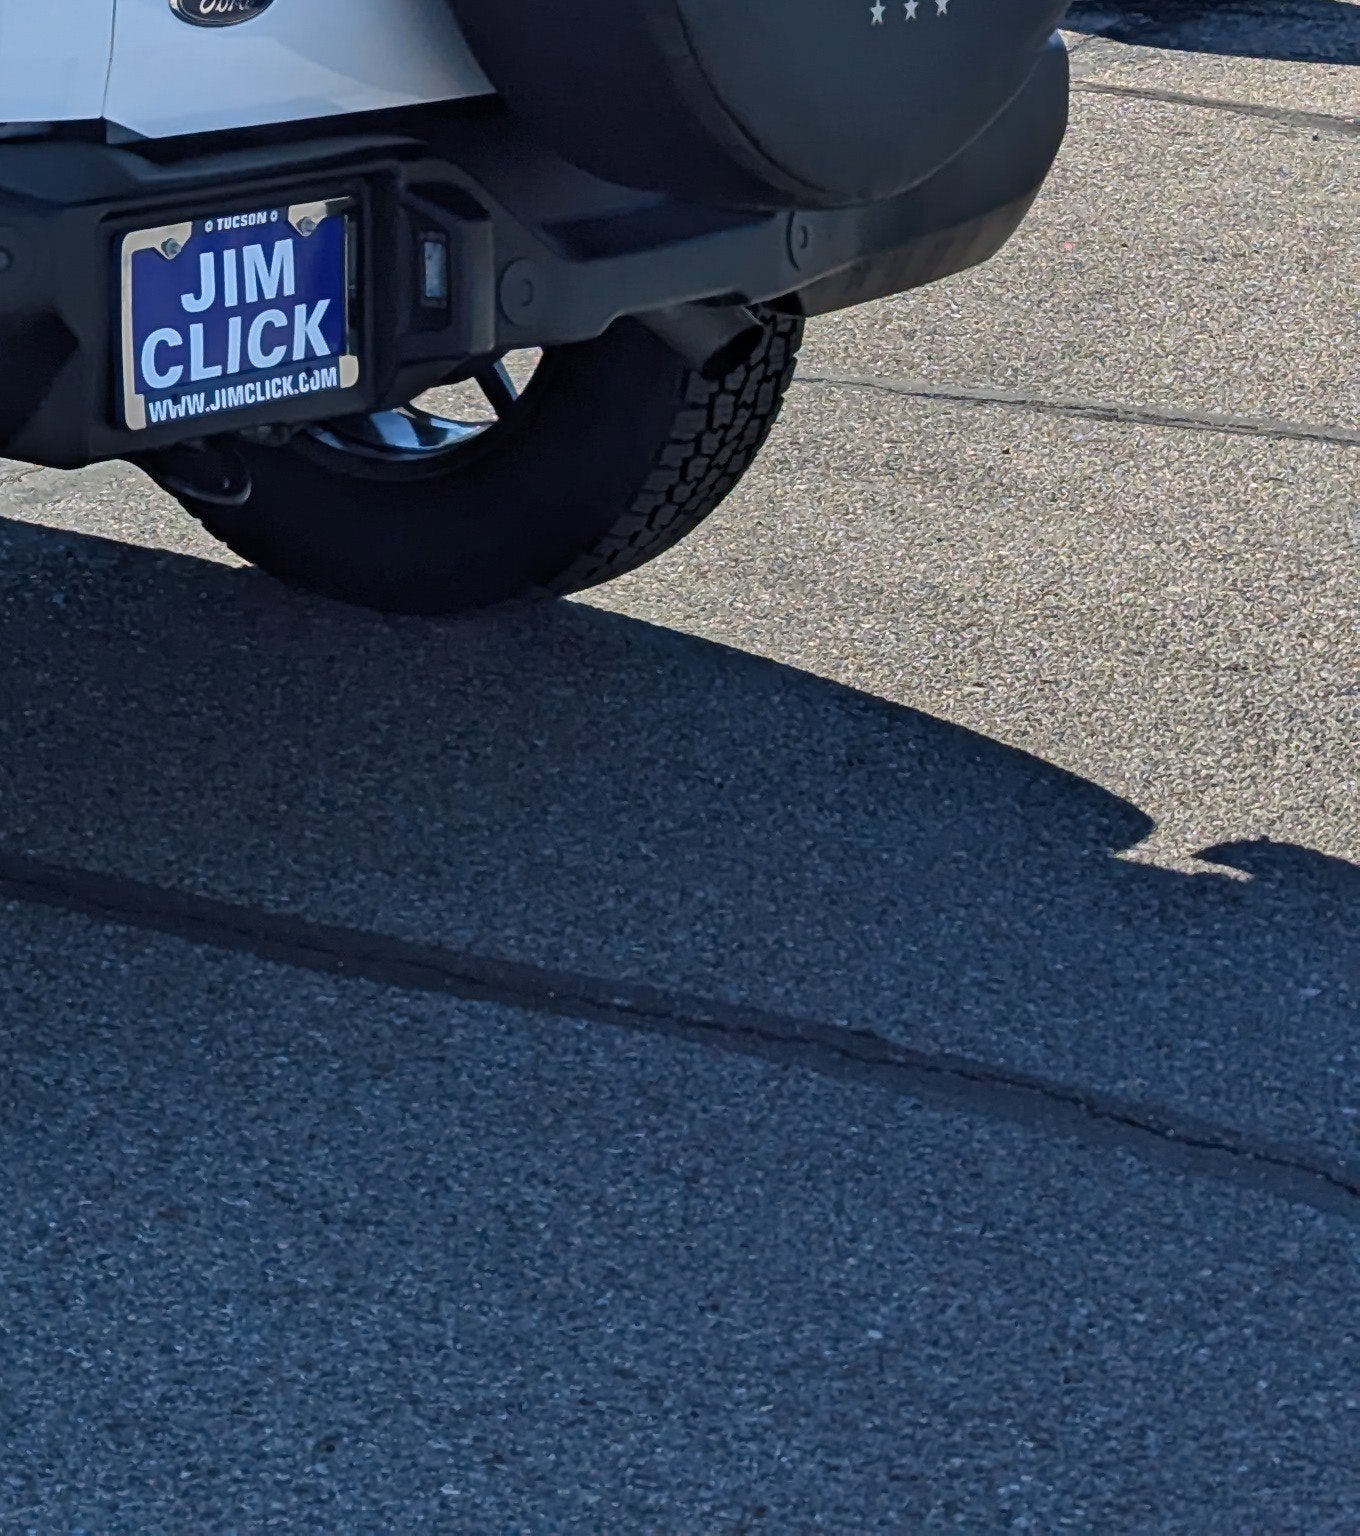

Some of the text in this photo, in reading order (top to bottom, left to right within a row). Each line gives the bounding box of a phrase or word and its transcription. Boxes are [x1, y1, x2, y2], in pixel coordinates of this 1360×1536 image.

[217, 211, 268, 231] TUCSON
[181, 238, 296, 313] JIM
[141, 298, 332, 389] CLICK
[148, 366, 338, 424] WWW.JIMCLICK.COM
